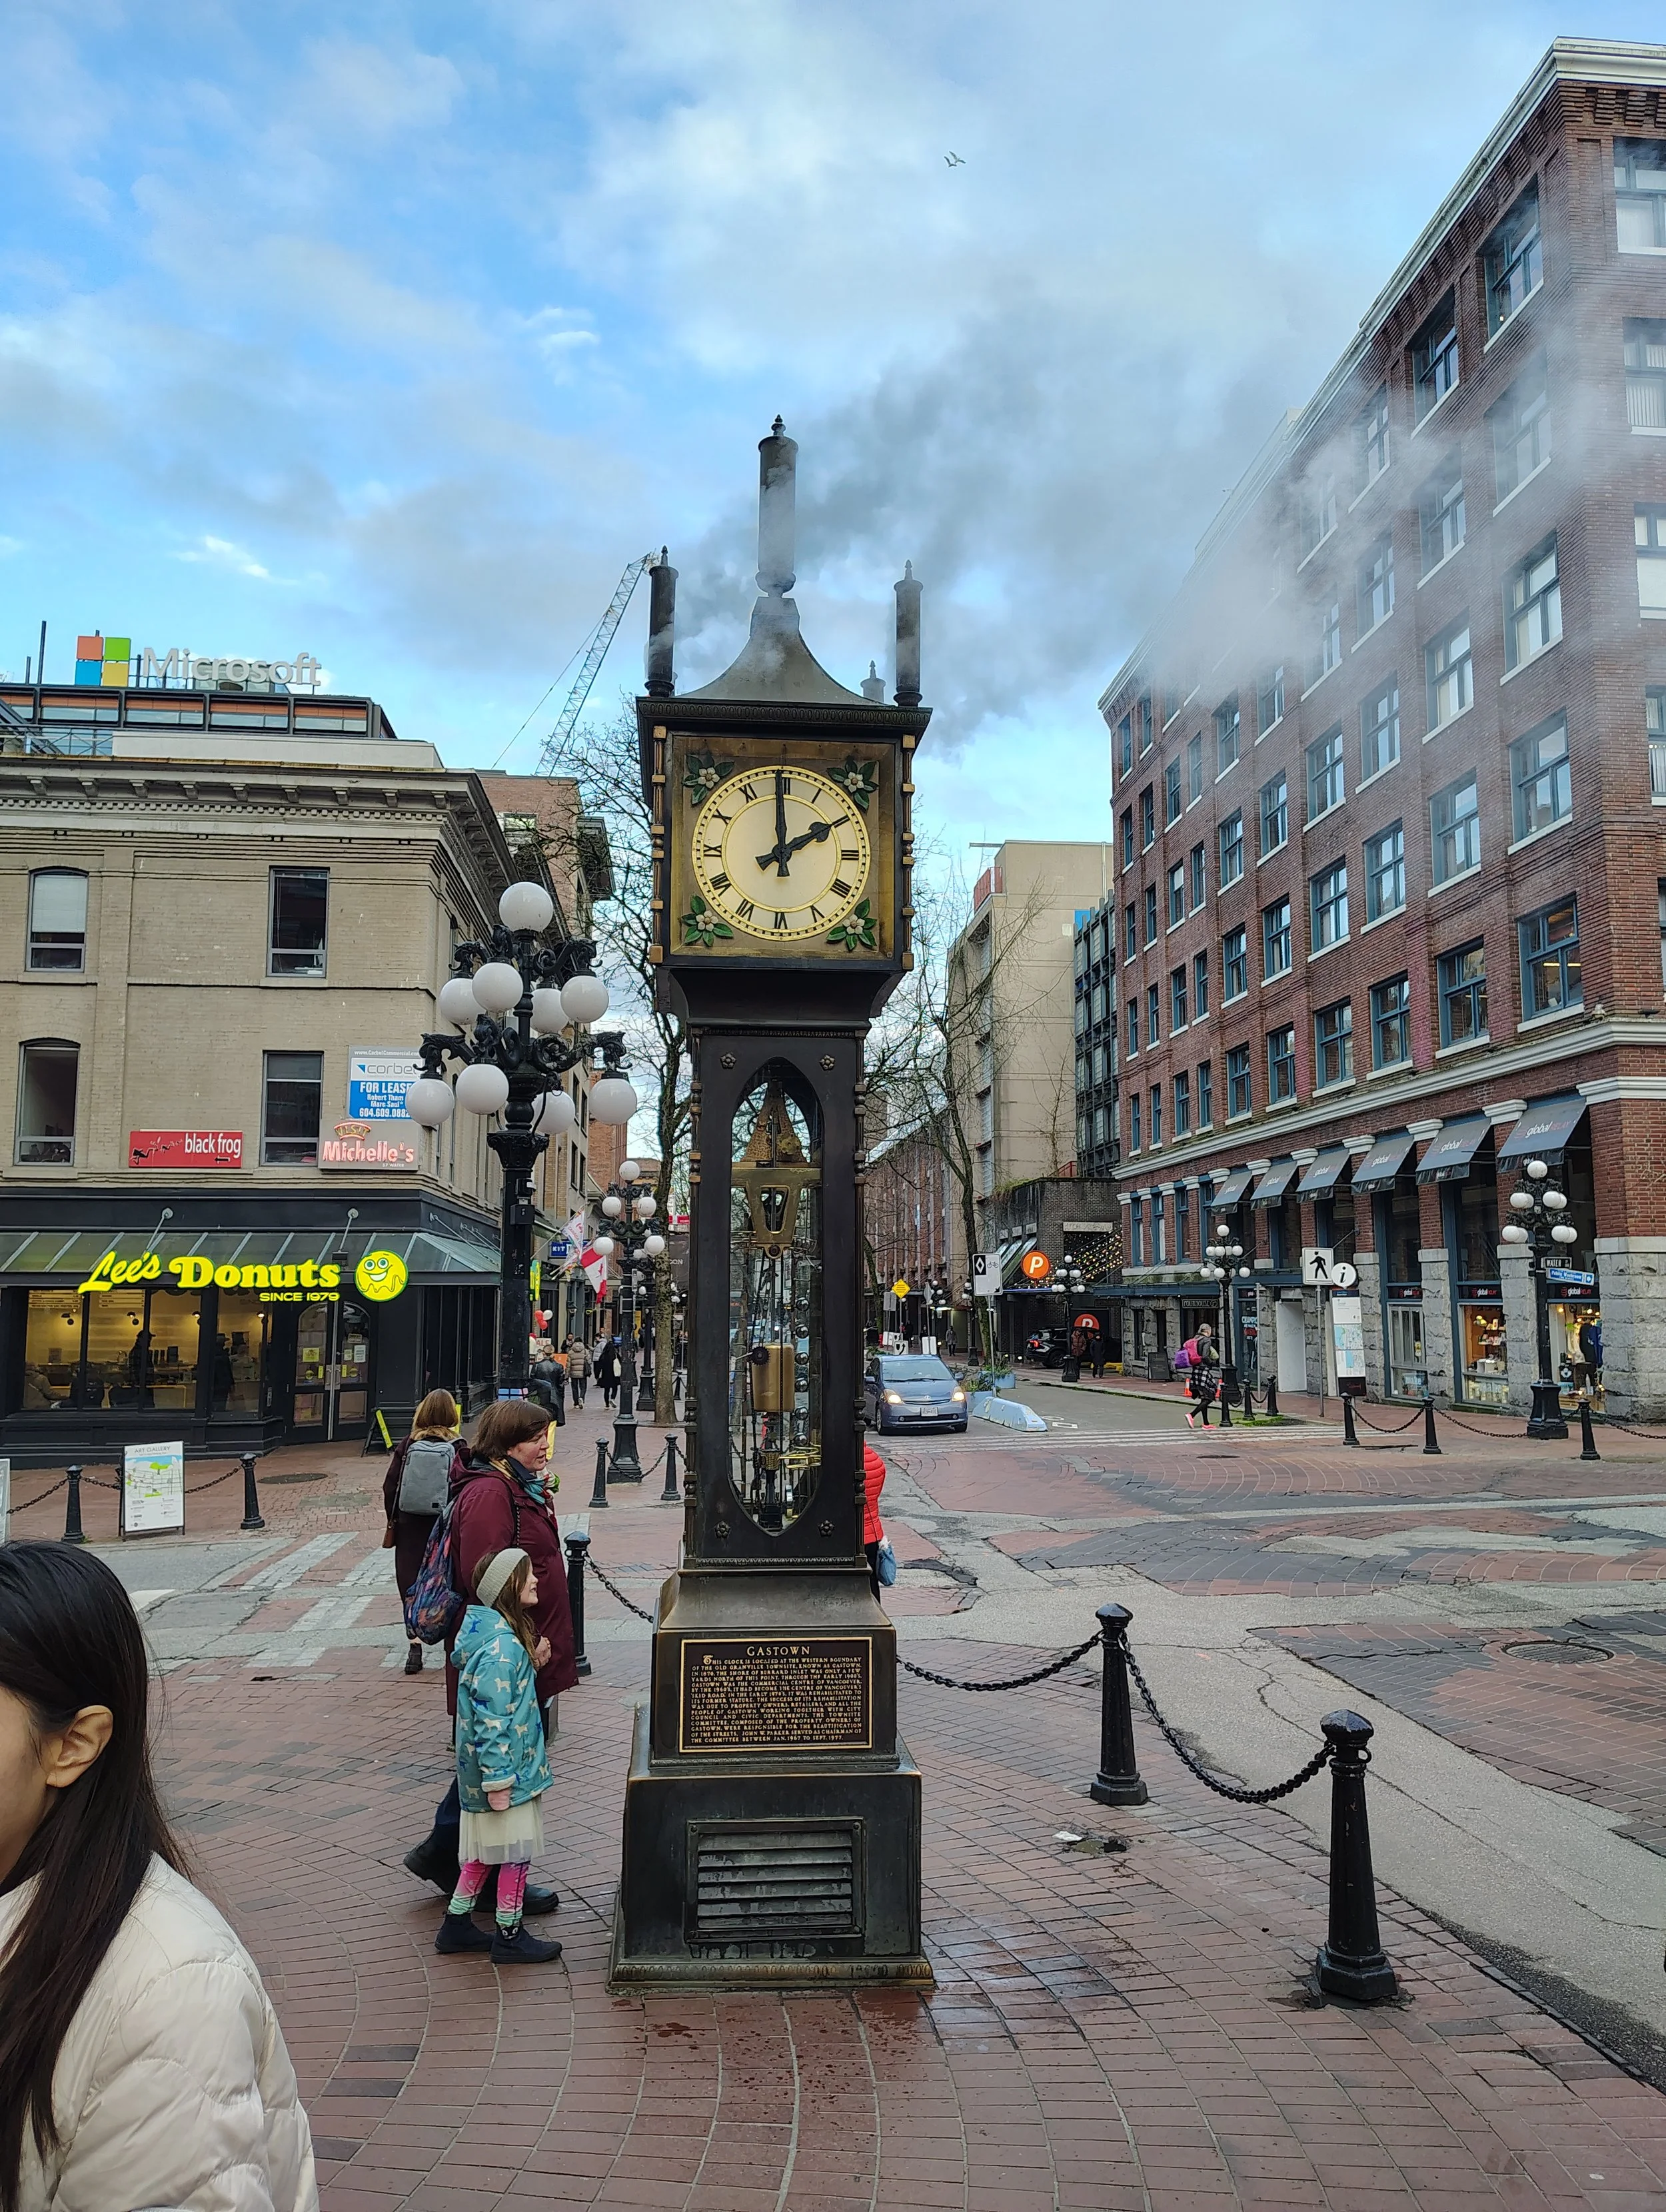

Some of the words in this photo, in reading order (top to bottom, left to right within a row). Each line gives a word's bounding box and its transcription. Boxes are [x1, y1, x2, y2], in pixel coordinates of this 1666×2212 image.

[143, 647, 321, 686] Microsoft
[842, 849, 860, 861] III
[360, 1082, 380, 1093] FOR
[335, 1125, 371, 1137] VISIT
[1525, 1121, 1553, 1139] global
[185, 1133, 215, 1153] black
[217, 1133, 242, 1159] frog
[323, 1140, 415, 1163] Michelle's
[1439, 1139, 1463, 1154] global
[1371, 1153, 1391, 1167] global
[1029, 1256, 1044, 1274] P
[1546, 1259, 1562, 1267] WATER
[77, 1251, 161, 1293] Lee's
[169, 1256, 341, 1289] Donuts
[259, 1293, 303, 1302] SINCE
[307, 1293, 341, 1301] 1979
[1477, 1288, 1488, 1297] global
[1568, 1287, 1581, 1297] global
[747, 1646, 810, 1656] GASTOWN
